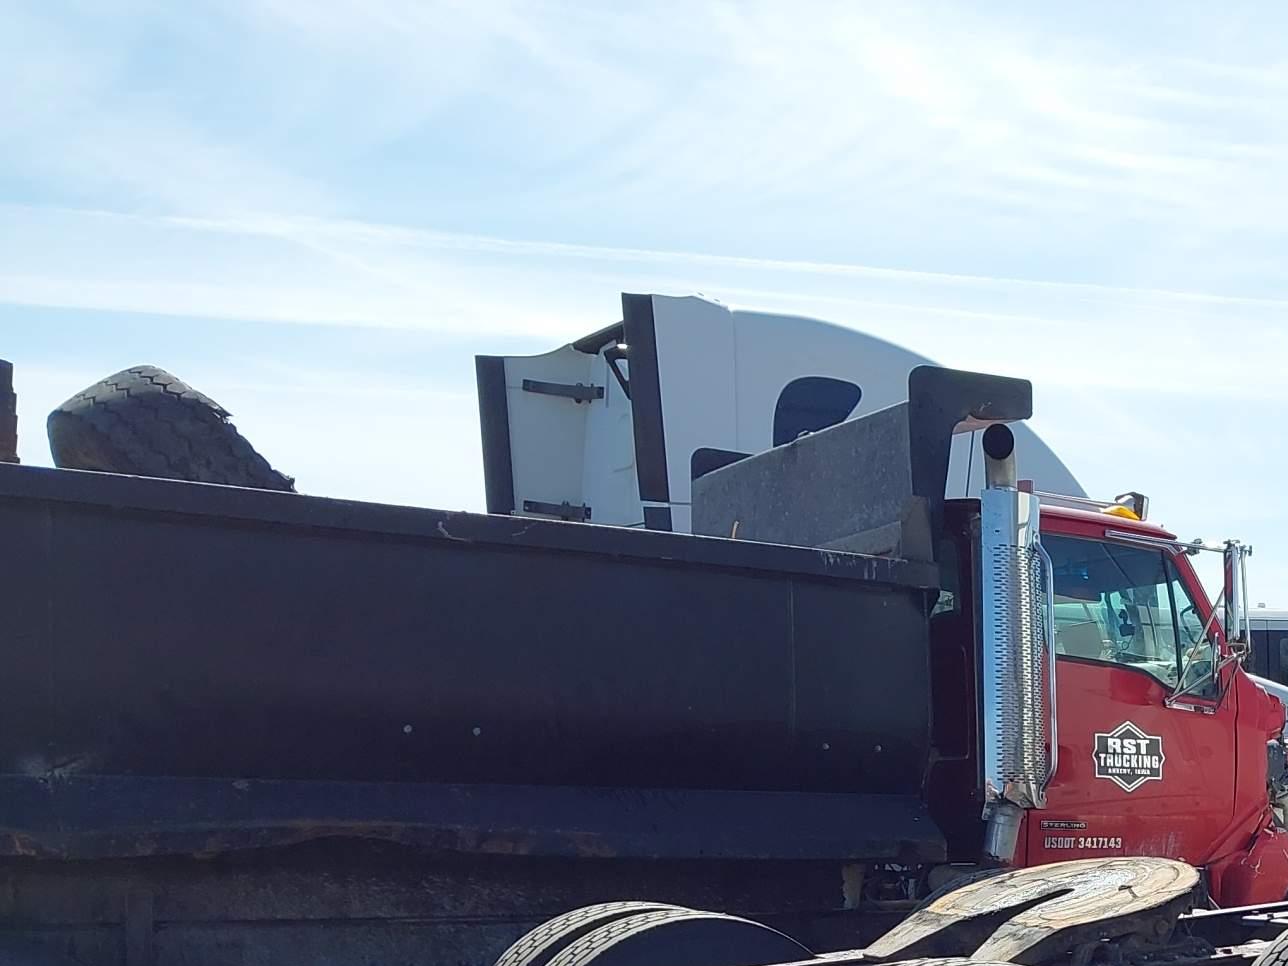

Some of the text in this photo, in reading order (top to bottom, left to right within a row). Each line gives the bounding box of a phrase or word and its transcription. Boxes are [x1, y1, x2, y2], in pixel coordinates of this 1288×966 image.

[1107, 737, 1150, 755] RST
[1099, 753, 1159, 769] TRUCKING
[1044, 837, 1122, 849] USDOT 3417143
